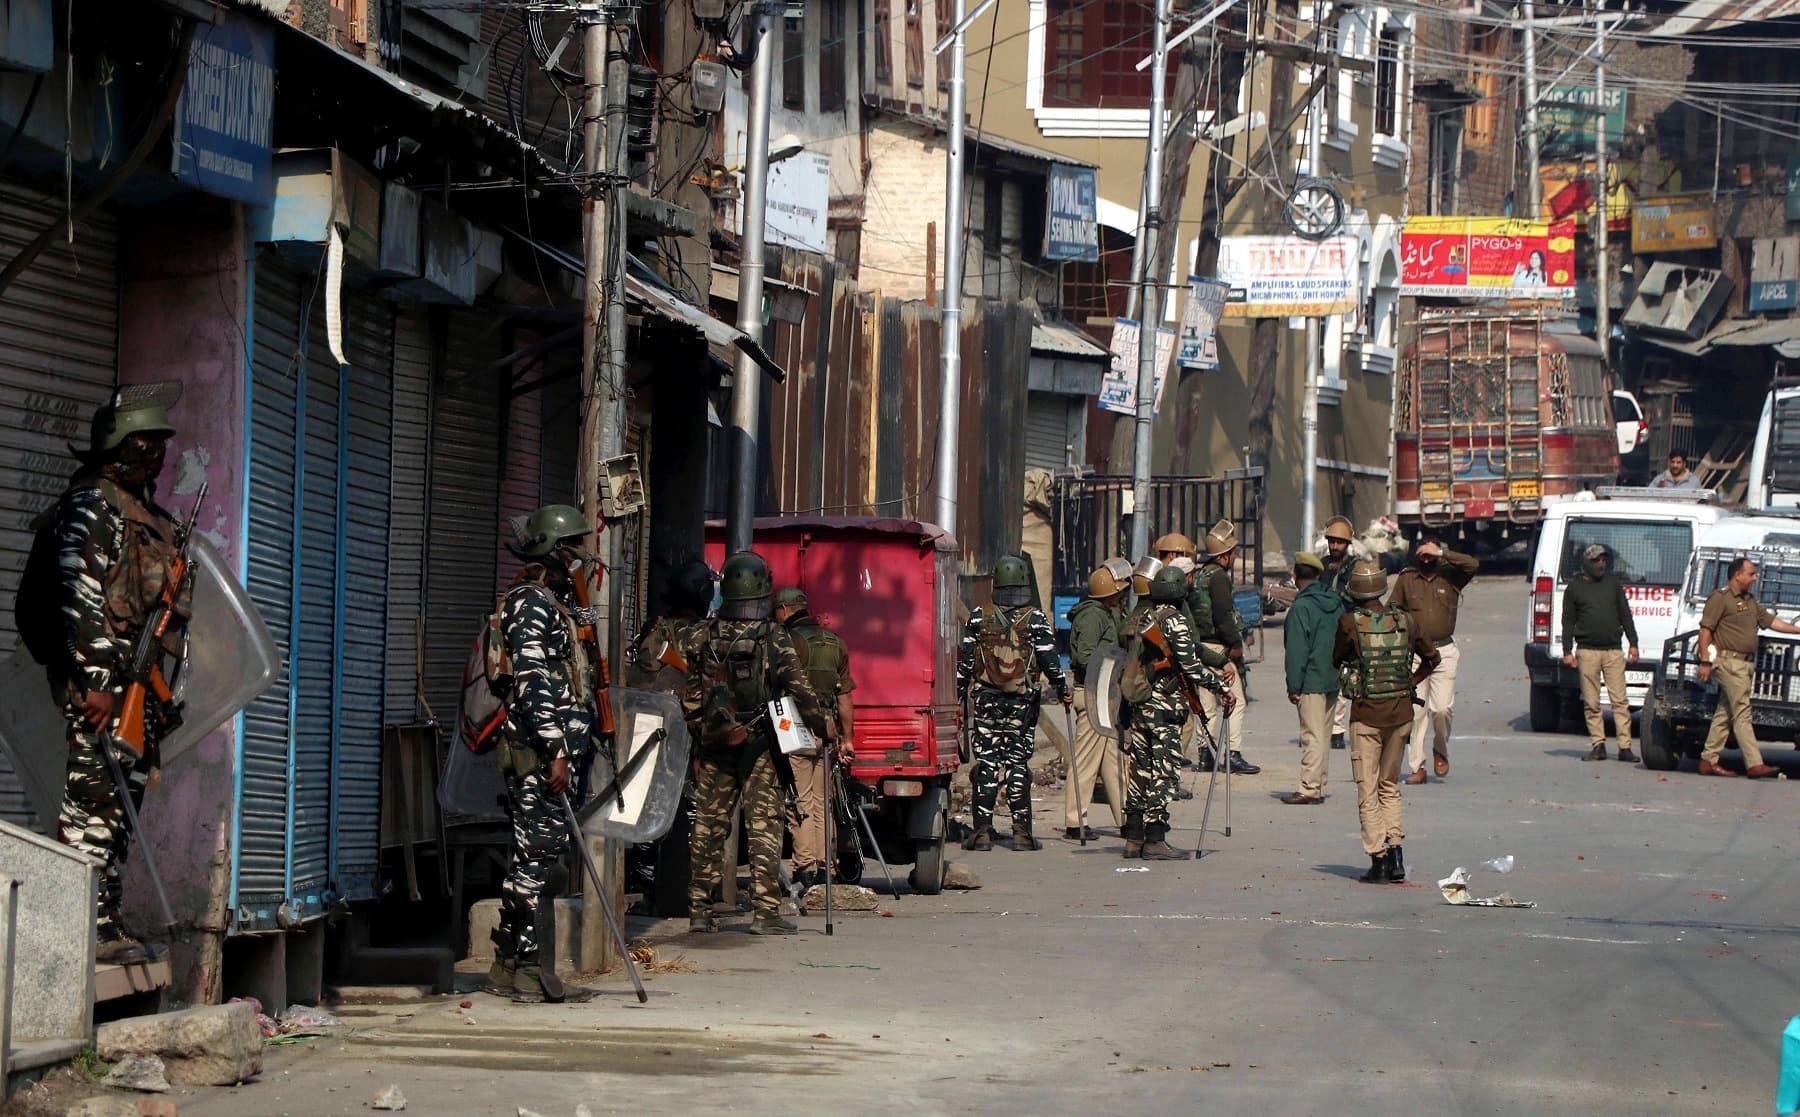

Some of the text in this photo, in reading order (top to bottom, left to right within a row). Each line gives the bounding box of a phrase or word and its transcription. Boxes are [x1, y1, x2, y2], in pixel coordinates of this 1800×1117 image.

[225, 52, 252, 143] BOOK
[250, 61, 273, 149] SHOP
[1052, 175, 1082, 215] ROYAL
[1472, 237, 1522, 250] PYGO-9
[1249, 247, 1346, 270] AHUJA
[1251, 279, 1295, 289] AMPLIFIERS
[1623, 585, 1673, 602] OLICE
[1630, 606, 1673, 617] SERVICE
